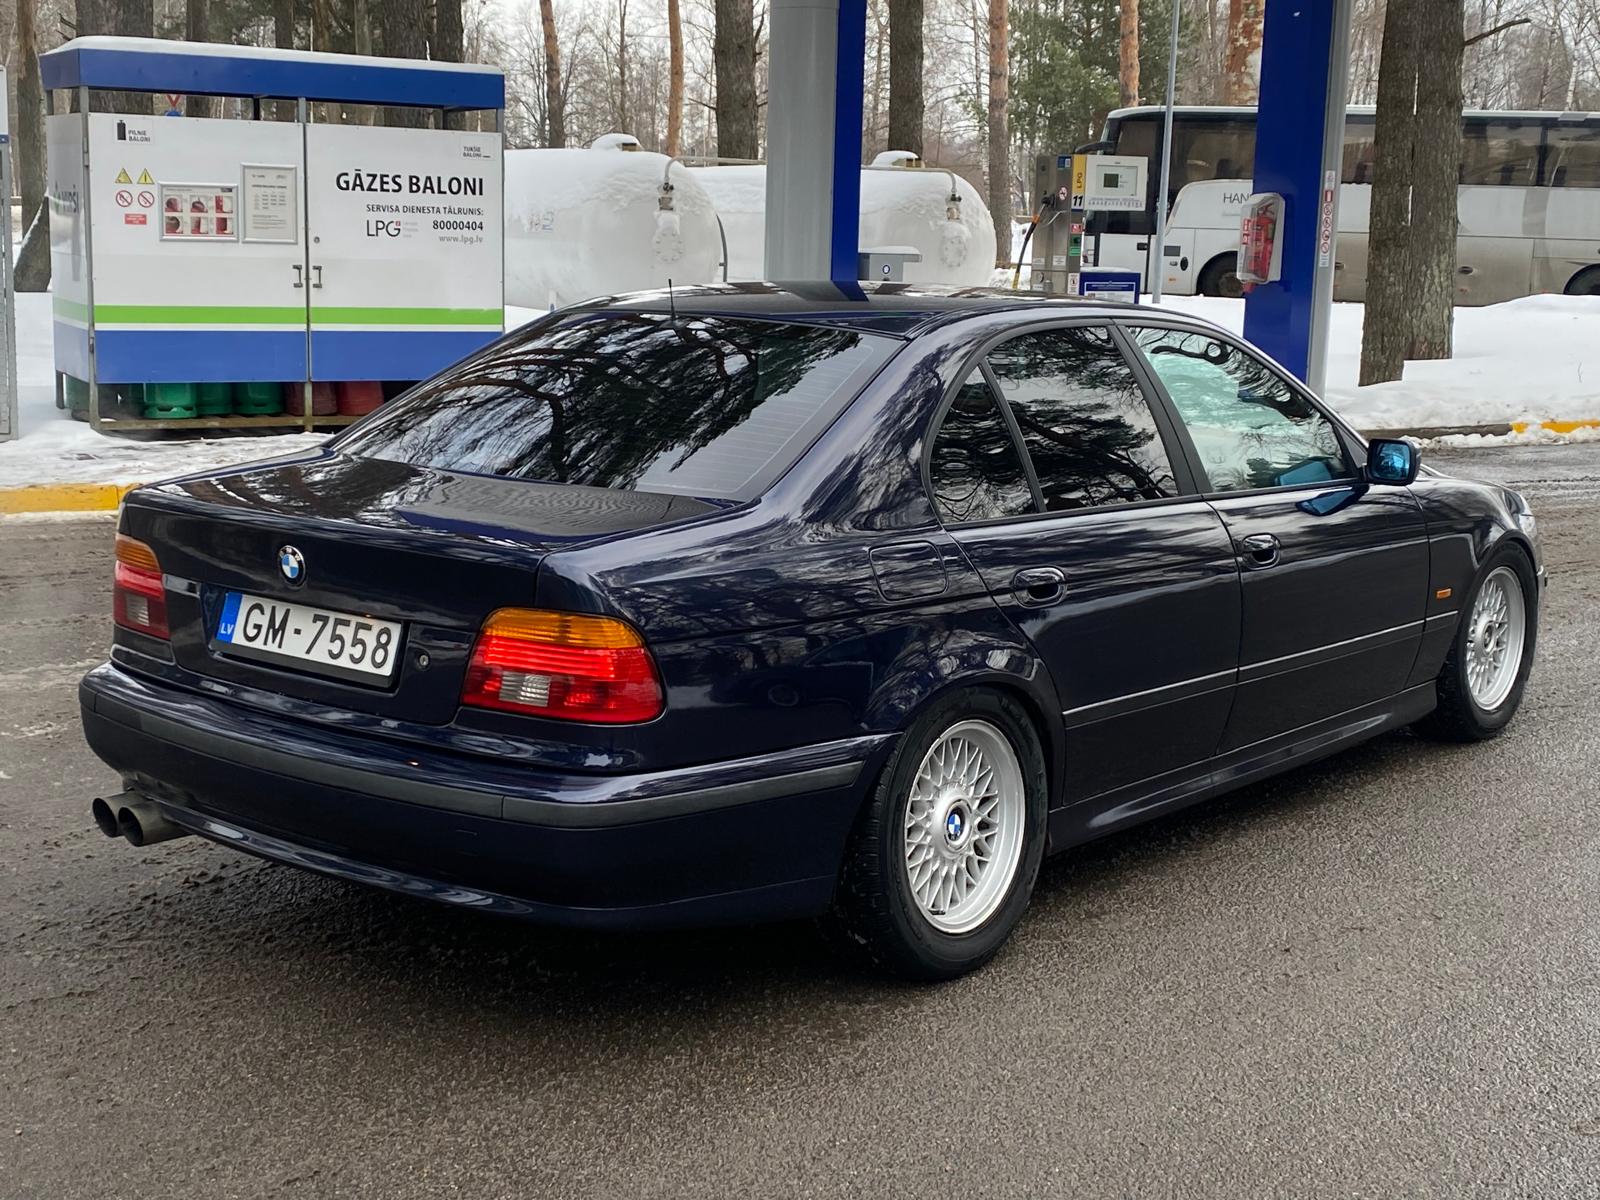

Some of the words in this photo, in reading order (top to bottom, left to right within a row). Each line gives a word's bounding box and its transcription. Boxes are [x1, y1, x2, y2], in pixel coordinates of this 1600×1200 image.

[335, 169, 402, 193] GĀZES
[408, 175, 484, 196] BALONI
[1073, 195, 1084, 206] 11
[366, 204, 400, 213] SERVISA
[402, 205, 441, 214] DIENESTA
[366, 219, 401, 237] LPG
[432, 219, 484, 231] 80000404
[438, 234, 484, 244] www.lpg.lv
[219, 622, 234, 635] LV
[242, 602, 392, 669] GM-7558
